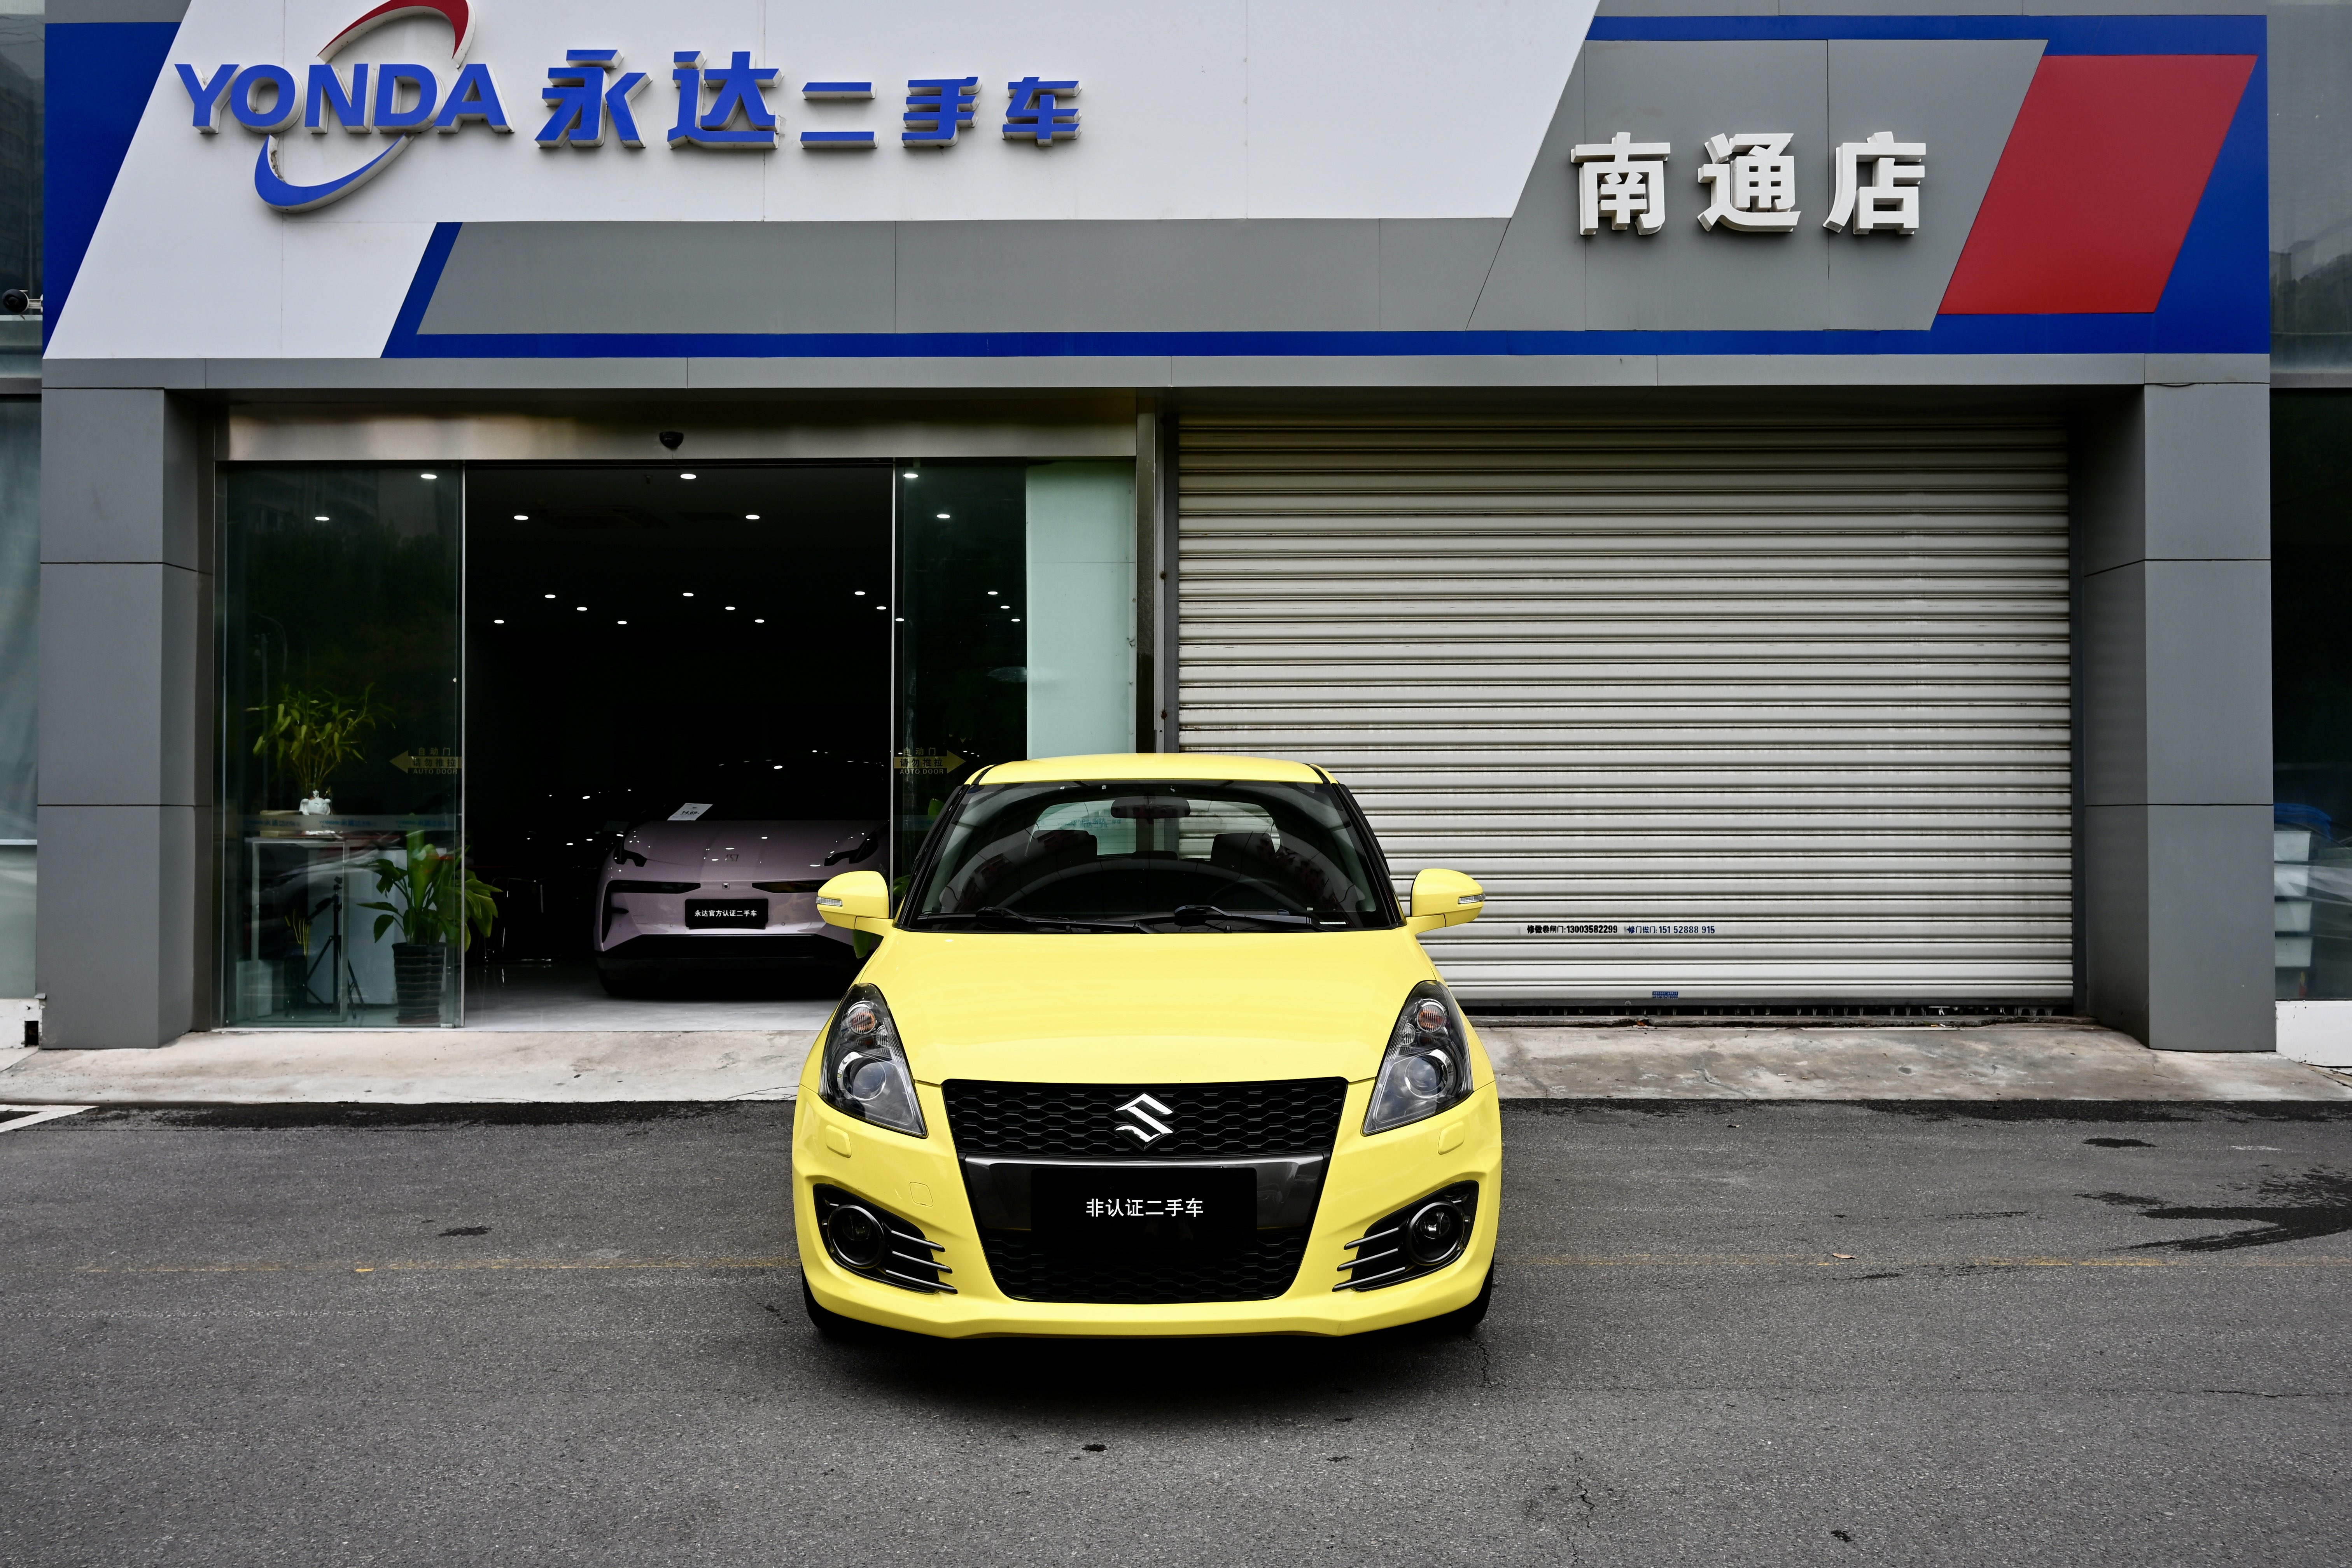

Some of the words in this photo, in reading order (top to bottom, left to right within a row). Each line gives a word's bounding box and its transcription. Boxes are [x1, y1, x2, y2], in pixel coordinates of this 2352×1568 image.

[174, 63, 513, 133] YONDA
[535, 49, 1082, 149] 永达二手车
[1571, 131, 1926, 235] 南通店
[418, 747, 450, 756] 自动门
[904, 747, 936, 756] 自动门
[413, 758, 455, 767] 请勿推拉
[900, 758, 943, 767] 请勿推拉
[1674, 926, 1699, 934] 52888
[1702, 926, 1715, 934] 915
[1086, 1198, 1204, 1217] 非认证二手车
